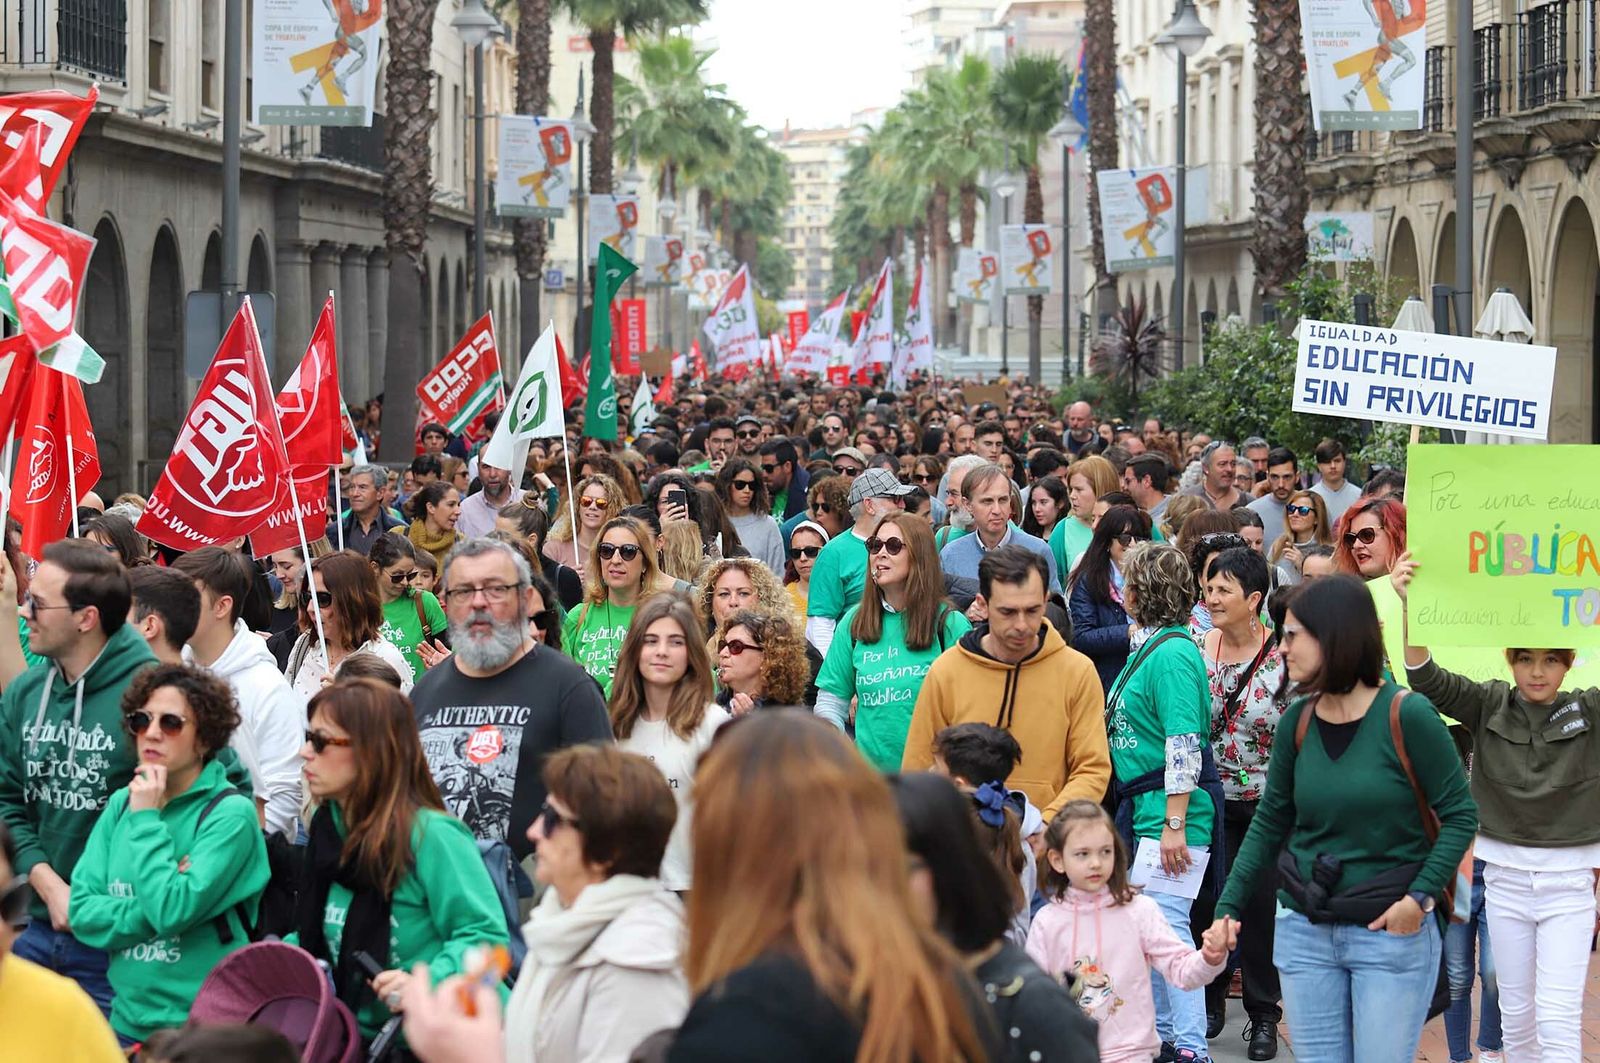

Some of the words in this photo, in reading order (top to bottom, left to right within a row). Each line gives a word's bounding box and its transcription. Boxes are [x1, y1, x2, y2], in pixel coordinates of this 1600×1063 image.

[1309, 324, 1398, 346] IGUALDAD
[1307, 344, 1475, 385] EDUCACIÓN
[1303, 377, 1350, 407] SIN
[1366, 384, 1538, 430] PRIVILEGIOS
[1429, 471, 1463, 513] Por
[1479, 492, 1536, 511] una
[1468, 520, 1600, 577] PÚBLICA
[1417, 600, 1503, 626] educación
[1510, 602, 1536, 627] de
[1552, 587, 1600, 628] TO
[862, 651, 884, 665] Por
[887, 645, 899, 659] la
[862, 687, 912, 706] Pública
[431, 705, 531, 726] AUTHENTIC
